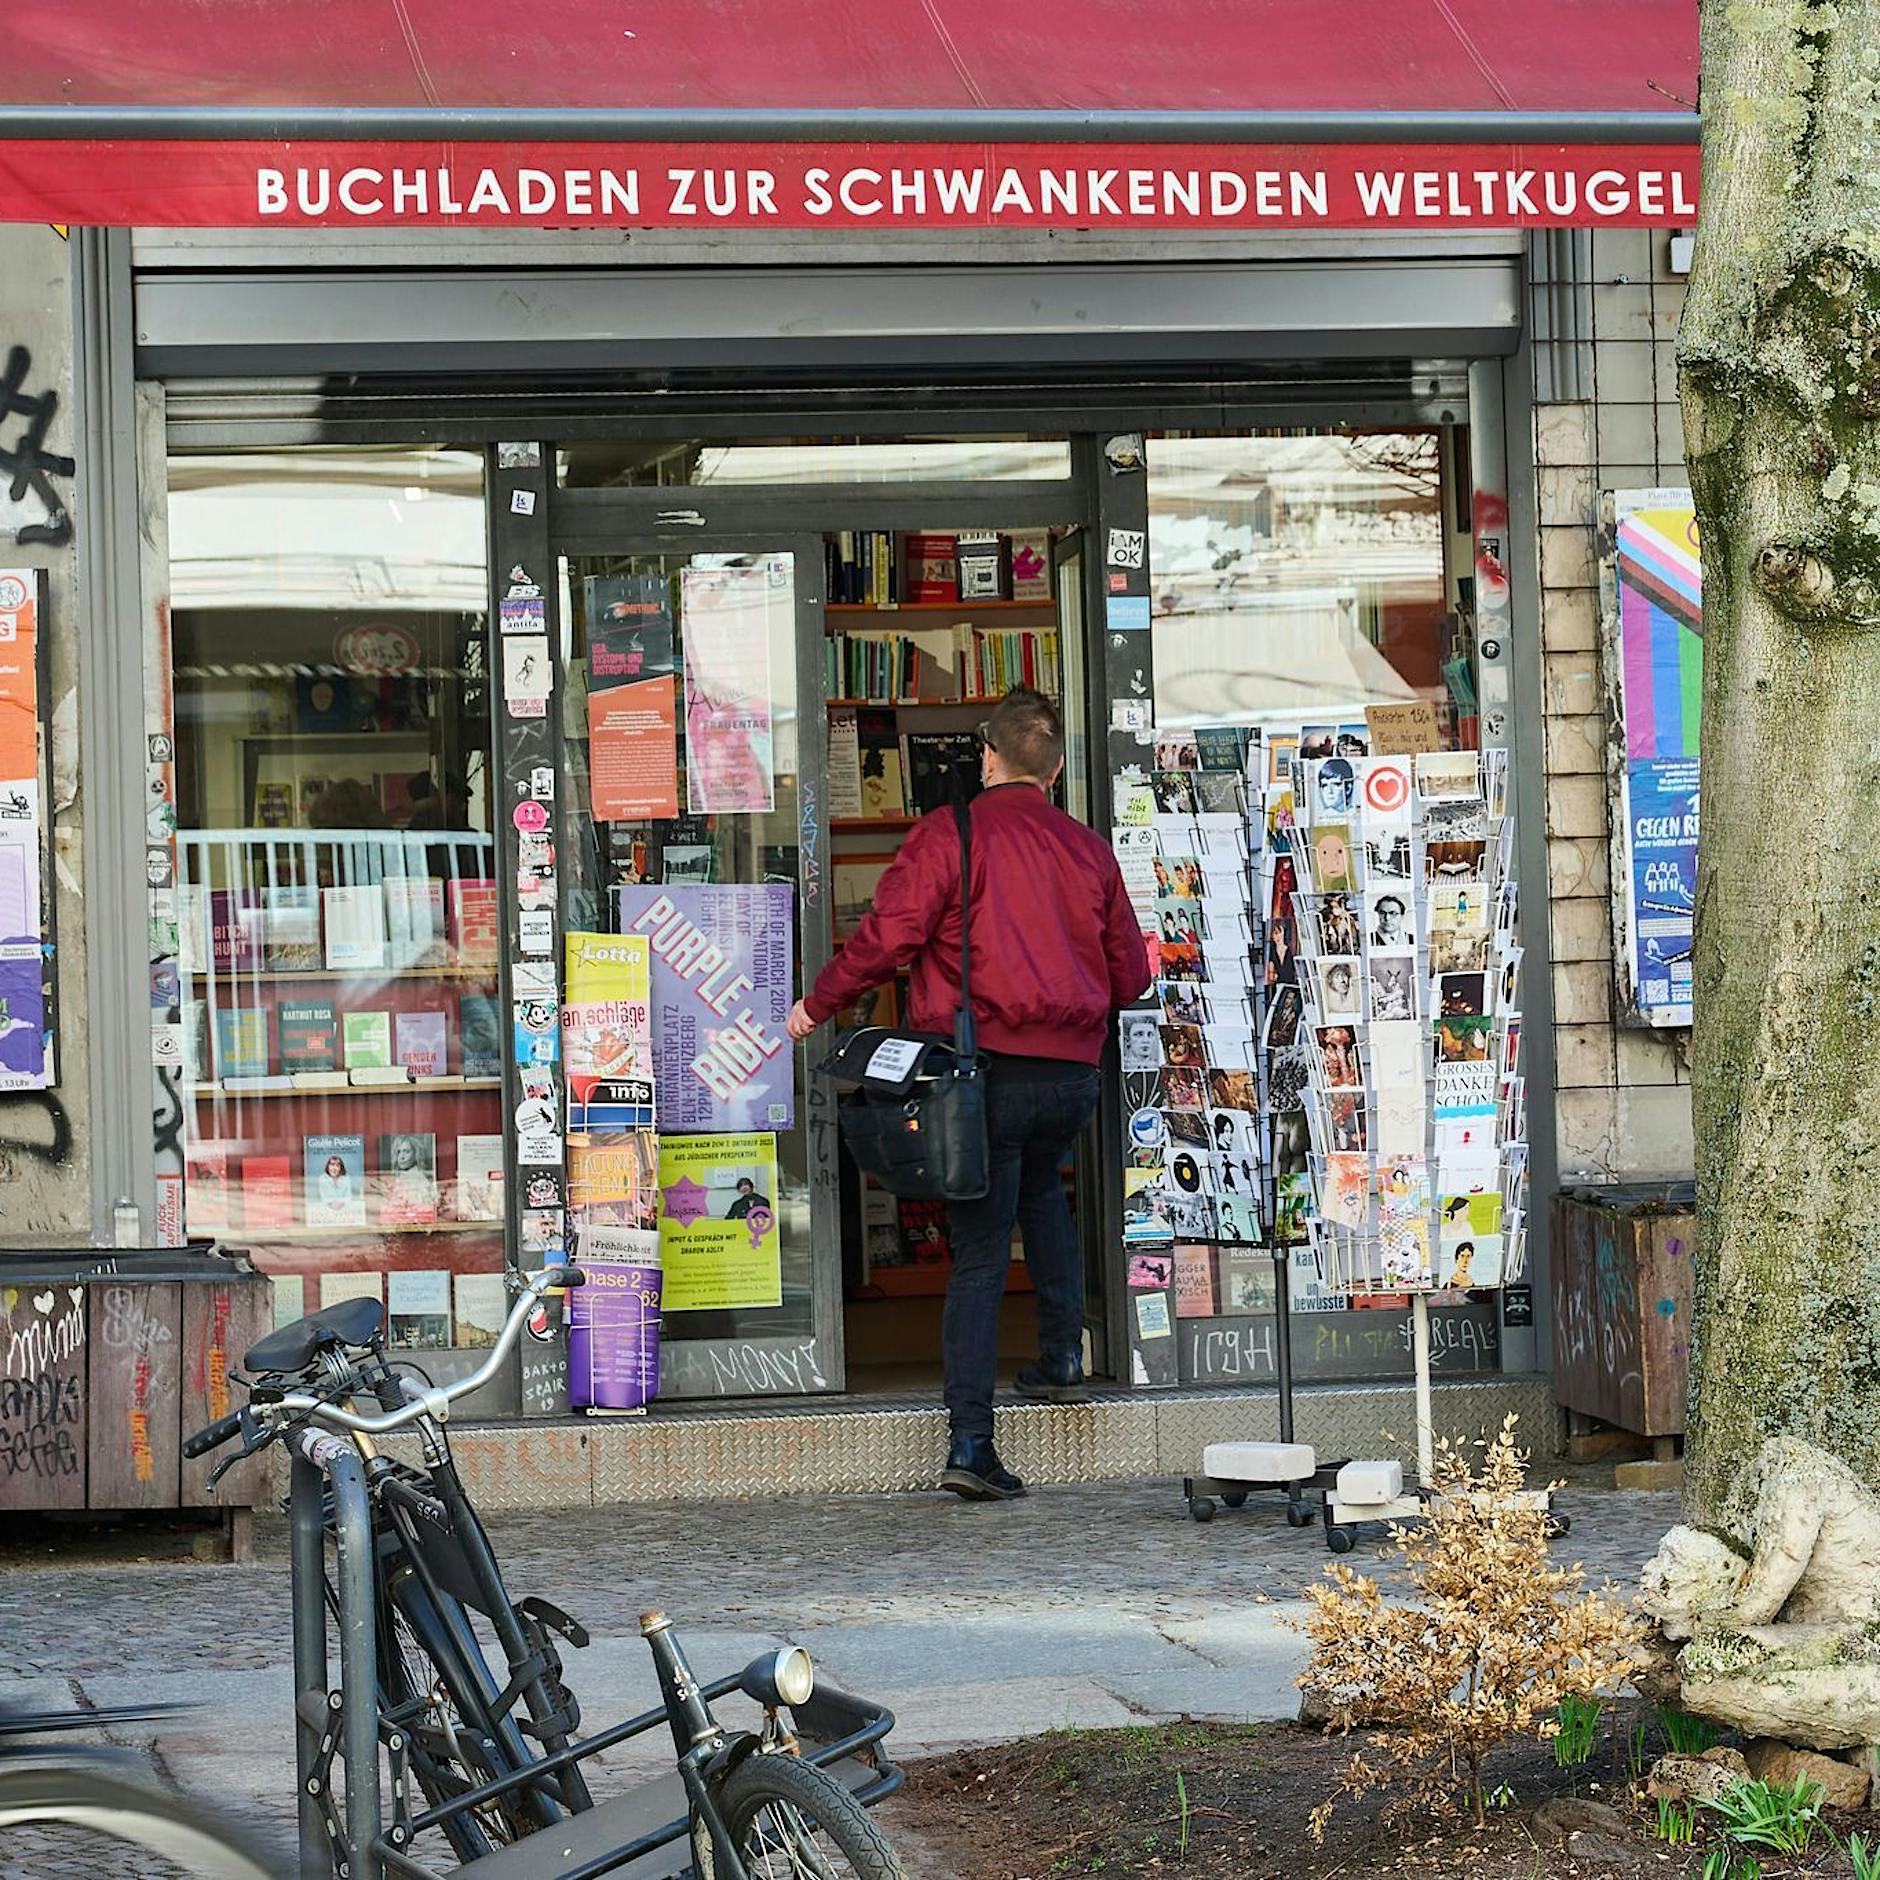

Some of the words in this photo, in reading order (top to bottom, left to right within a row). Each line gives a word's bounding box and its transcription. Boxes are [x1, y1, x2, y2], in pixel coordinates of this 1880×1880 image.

[257, 168, 639, 216] BUCHLADEN
[667, 169, 779, 216] ZUR
[803, 168, 1328, 217] SCHWANKENDEN
[1354, 169, 1697, 218] WELTKUGEL
[1114, 549, 1140, 565] OK
[507, 619, 538, 630] antifa
[1635, 816, 1680, 839] GEGEN
[735, 893, 751, 917] DAY
[718, 893, 734, 952] FEMINIST
[735, 921, 751, 937] OF
[771, 921, 786, 938] OF
[752, 893, 769, 993] INTERNATIONAL
[631, 895, 755, 1019] PURPLE
[771, 940, 786, 987] MARCH
[771, 989, 786, 1024] 2026
[663, 1004, 680, 1124] MARIANNENPLATZ
[689, 1007, 782, 1100] RIDE
[680, 1014, 697, 1124] BLN-KREUZBERG
[1437, 1062, 1494, 1076] GROSSES
[1437, 1075, 1494, 1091] DANKE
[582, 1268, 628, 1288] hase
[630, 1271, 642, 1289] 2
[640, 1289, 660, 1308] 62
[1294, 1295, 1344, 1311] bewusste
